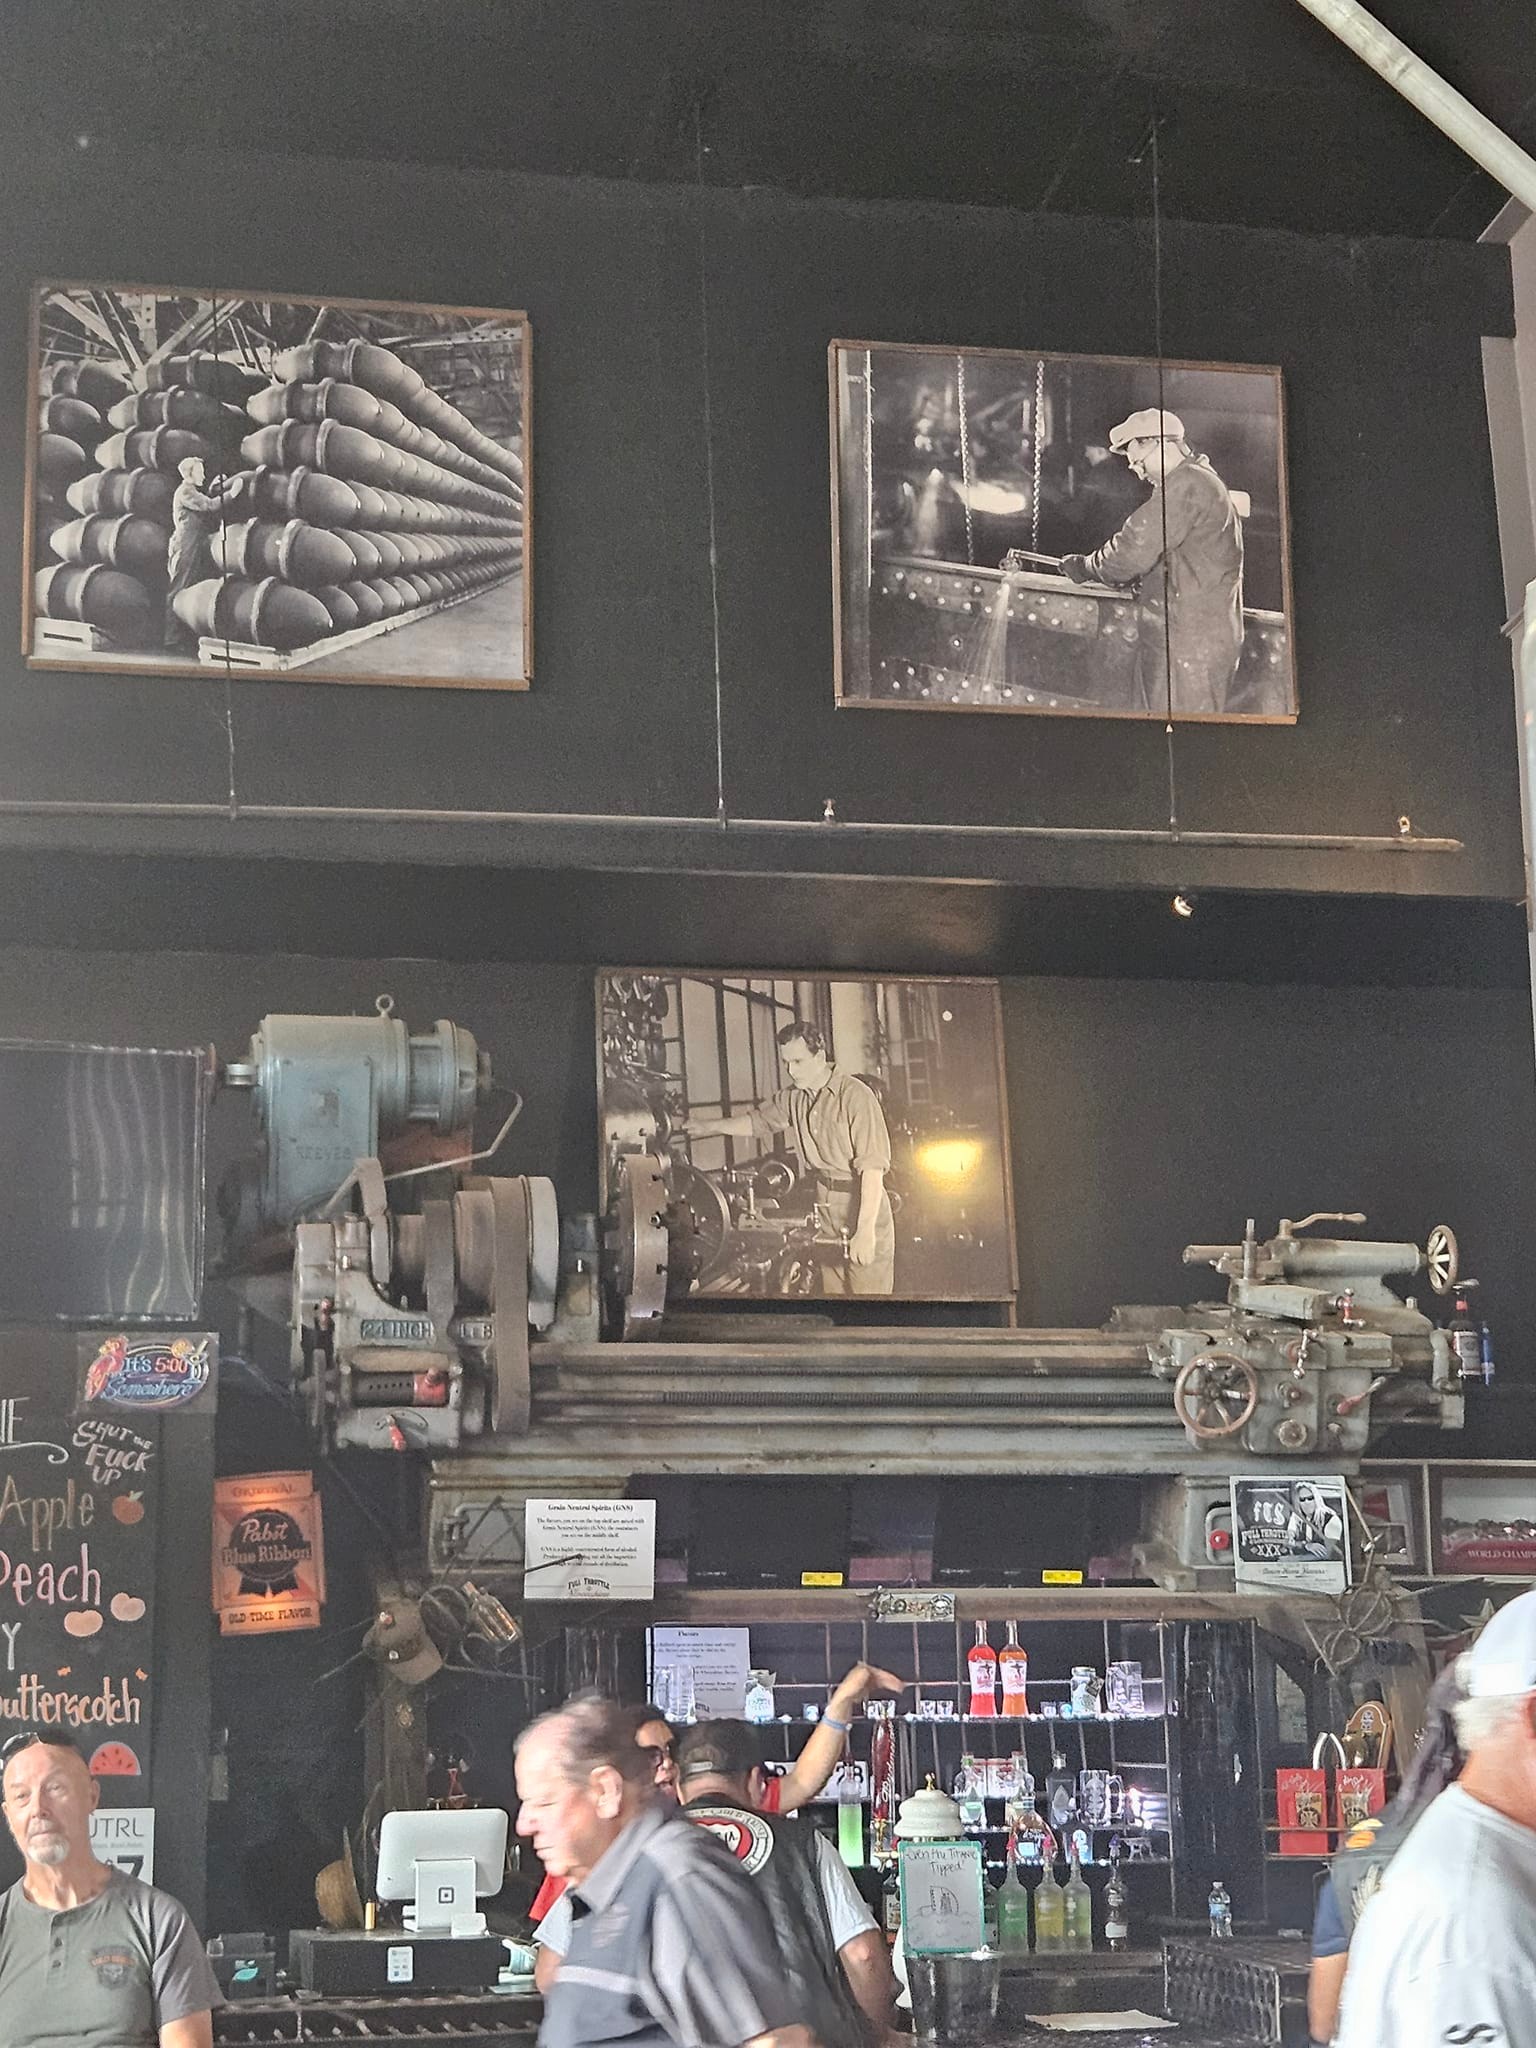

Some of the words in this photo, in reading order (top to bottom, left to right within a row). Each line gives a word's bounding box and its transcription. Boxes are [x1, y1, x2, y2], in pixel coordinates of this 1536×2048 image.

[124, 1356, 152, 1373] It's
[154, 1357, 188, 1373] 5:00
[101, 1375, 193, 1399] Somewhere
[72, 1420, 133, 1447] SHUT
[85, 1443, 155, 1472] FUCK
[92, 1465, 122, 1486] UP
[0, 1475, 95, 1552] Apple
[240, 1518, 289, 1543] Pabst
[223, 1548, 257, 1566] Blue
[258, 1544, 312, 1564] Ribbon
[1257, 1543, 1282, 1558] XXX
[228, 1613, 247, 1625] OLD
[250, 1609, 275, 1623] TIME
[278, 1606, 313, 1620] FLAVOR
[0, 1673, 140, 1727] utterscotch
